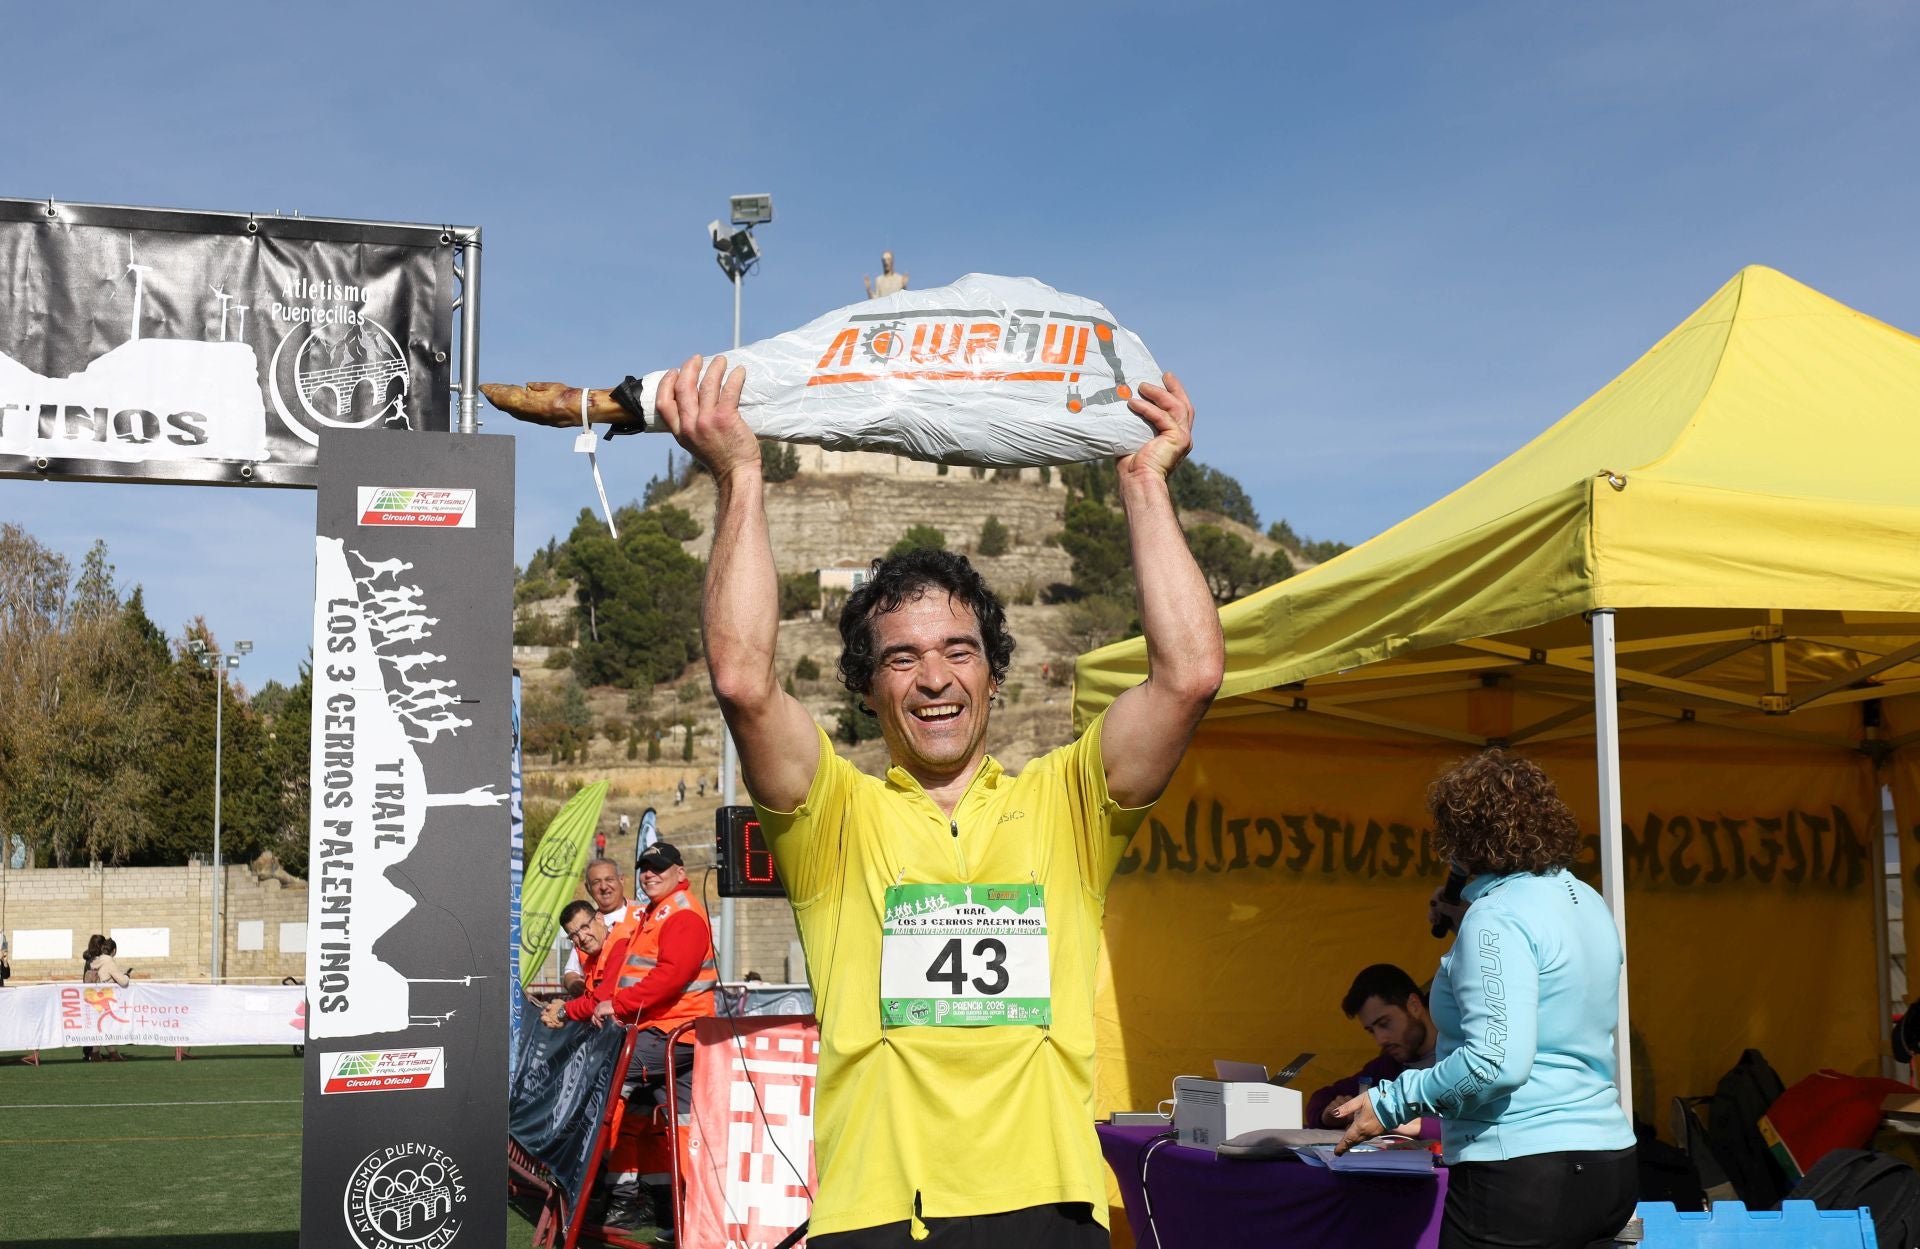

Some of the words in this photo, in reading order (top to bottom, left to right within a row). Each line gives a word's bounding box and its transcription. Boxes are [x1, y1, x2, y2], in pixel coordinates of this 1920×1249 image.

[282, 278, 370, 303] Atletismo
[271, 302, 365, 326] Puentecillas
[416, 491, 451, 499] RFEA
[418, 514, 446, 522] Oficial
[327, 598, 359, 654] LOS
[326, 664, 356, 682] 3
[323, 693, 356, 809] CERROS
[371, 758, 405, 850] TRAIL
[898, 918, 917, 926] LOS
[921, 918, 927, 926] 3
[931, 918, 973, 926] CERROS
[925, 938, 1010, 995] 43
[61, 987, 82, 1029] PMD
[65, 1034, 103, 1042] Patronato
[378, 1059, 433, 1067] ATLETISMO
[381, 1052, 418, 1060] RFEA
[346, 1079, 381, 1087] Circuito
[384, 1077, 413, 1086] Oficial
[352, 1157, 381, 1232] ATLETISMO
[385, 1142, 467, 1203] PUENTECILLAS
